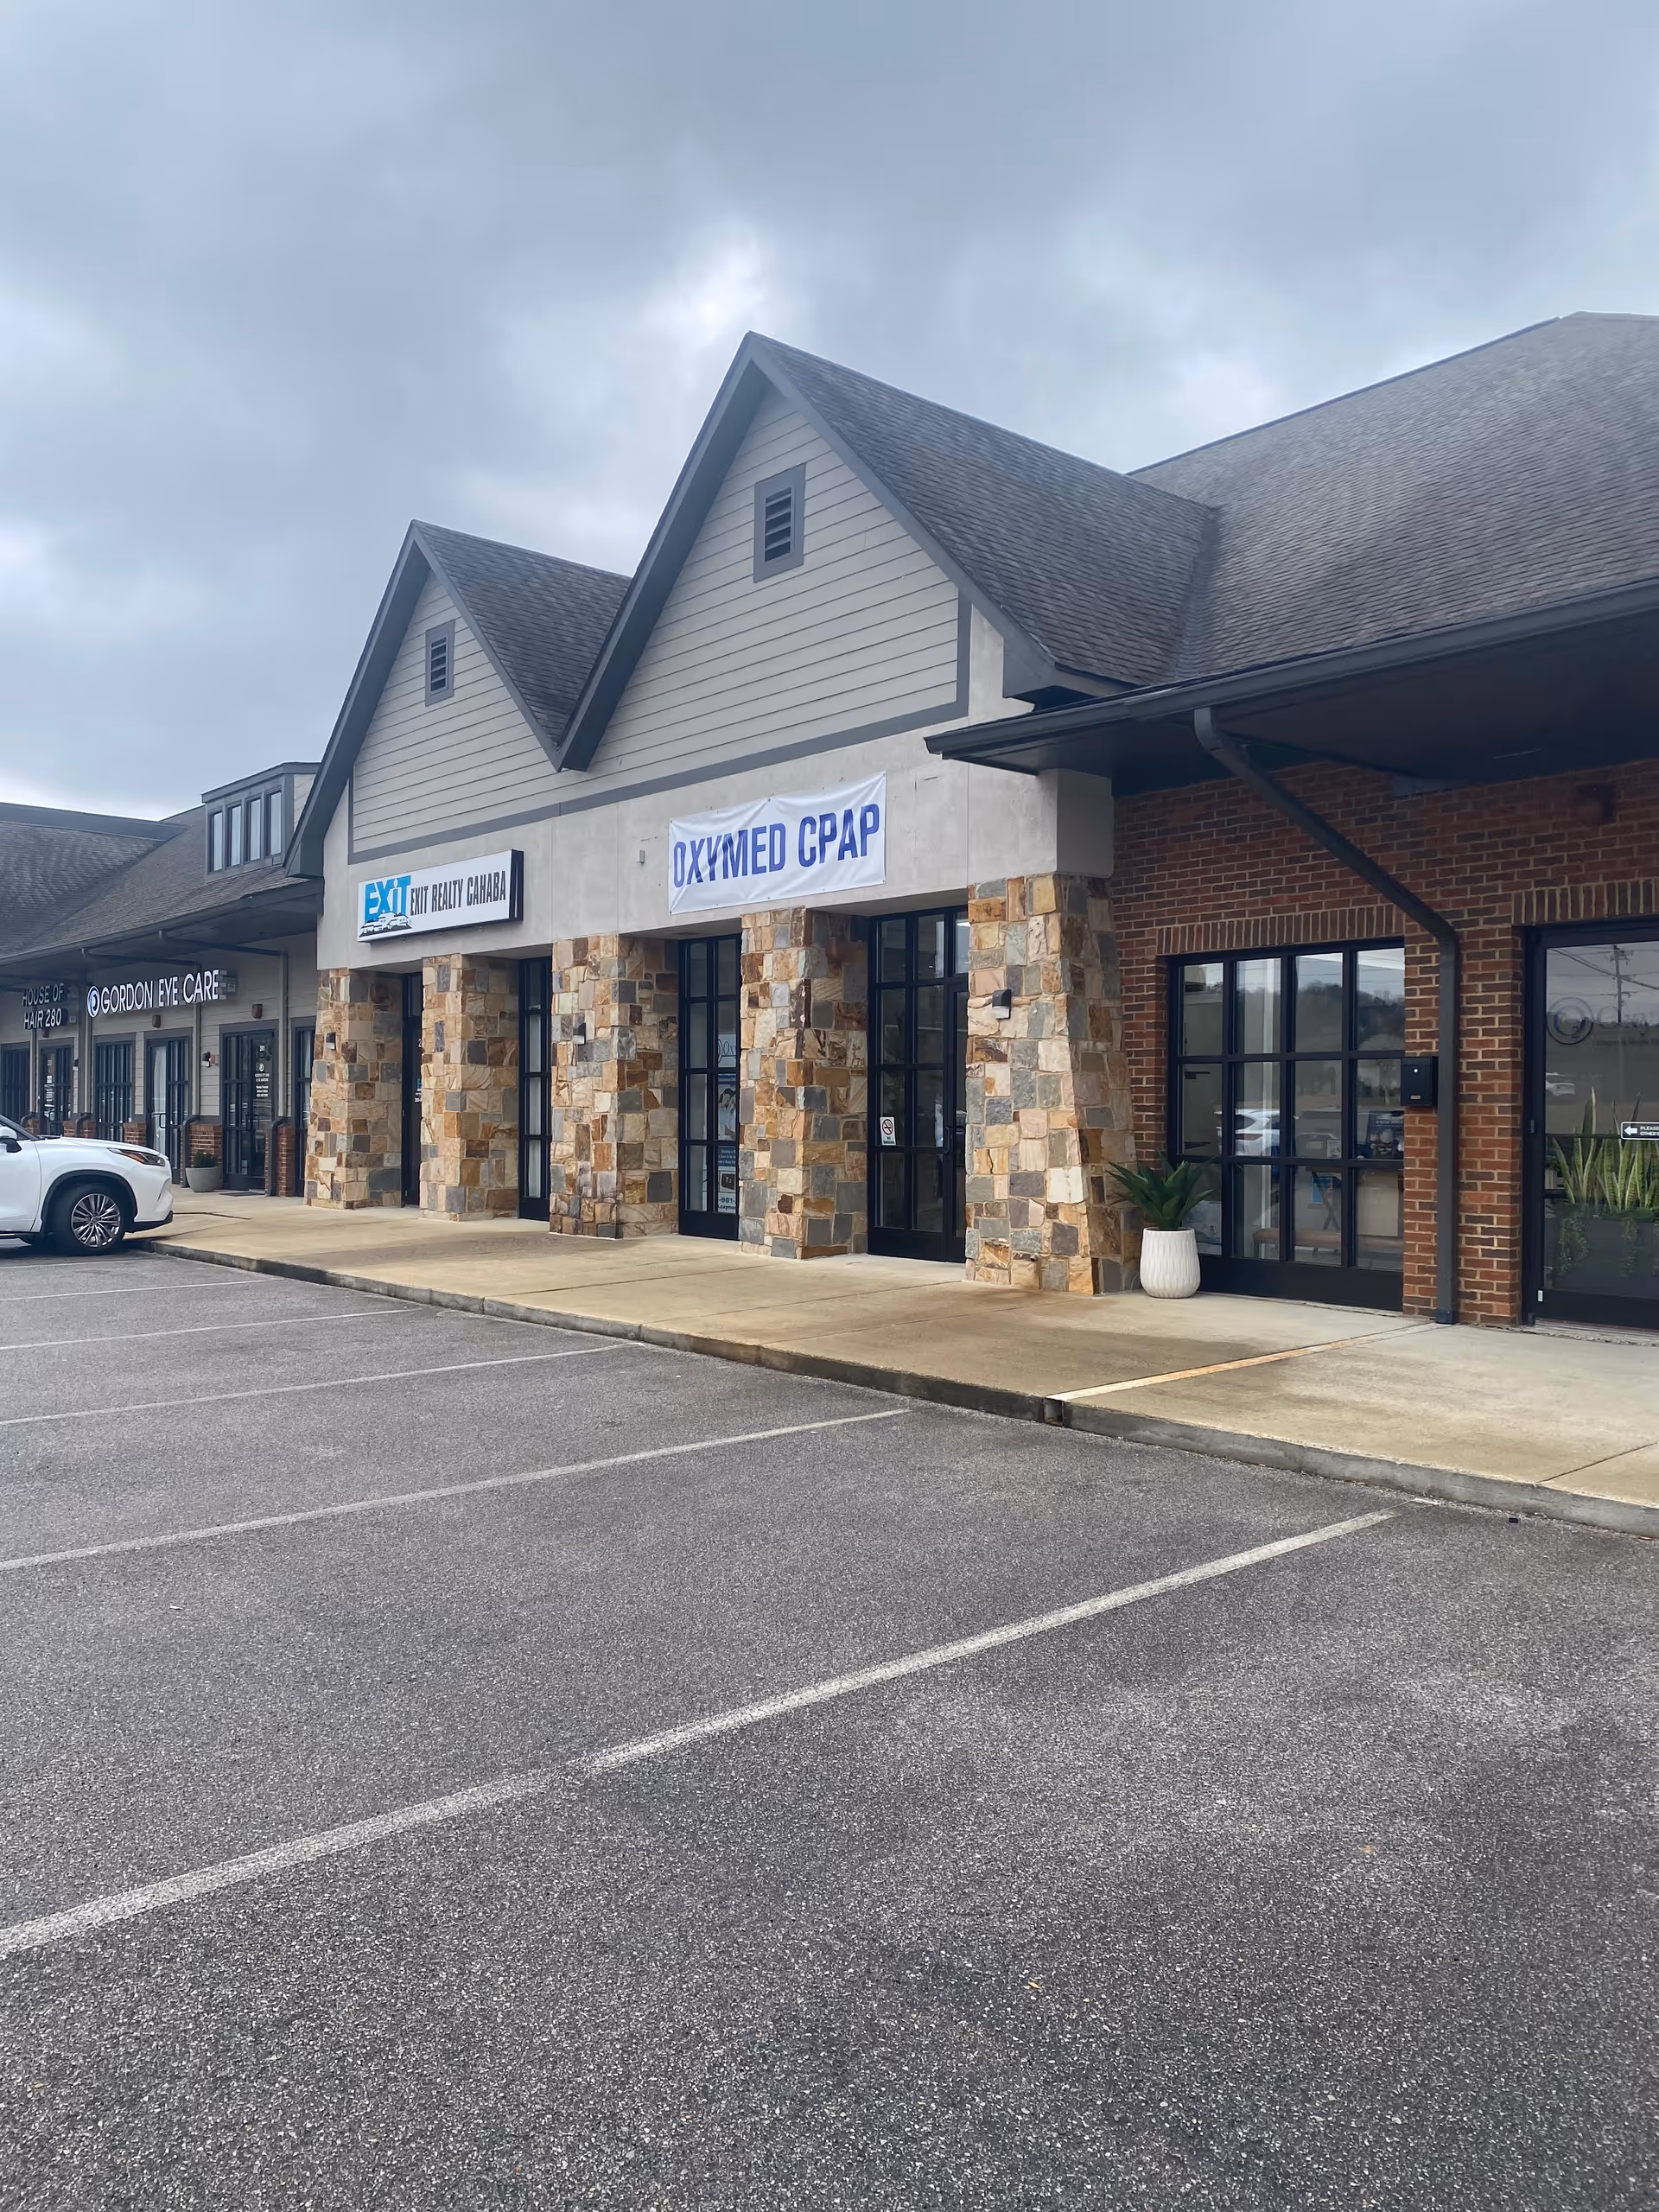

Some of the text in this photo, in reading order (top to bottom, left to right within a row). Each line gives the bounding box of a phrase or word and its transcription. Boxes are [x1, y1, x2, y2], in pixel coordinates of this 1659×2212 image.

[673, 804, 880, 888] OXYMED CPAP
[410, 870, 506, 916] EXIT REALTY CAHABA
[22, 982, 65, 1007] HOUSE OF
[100, 969, 219, 1014] GORDON EYE CARE
[23, 1007, 62, 1030] HAIR 280
